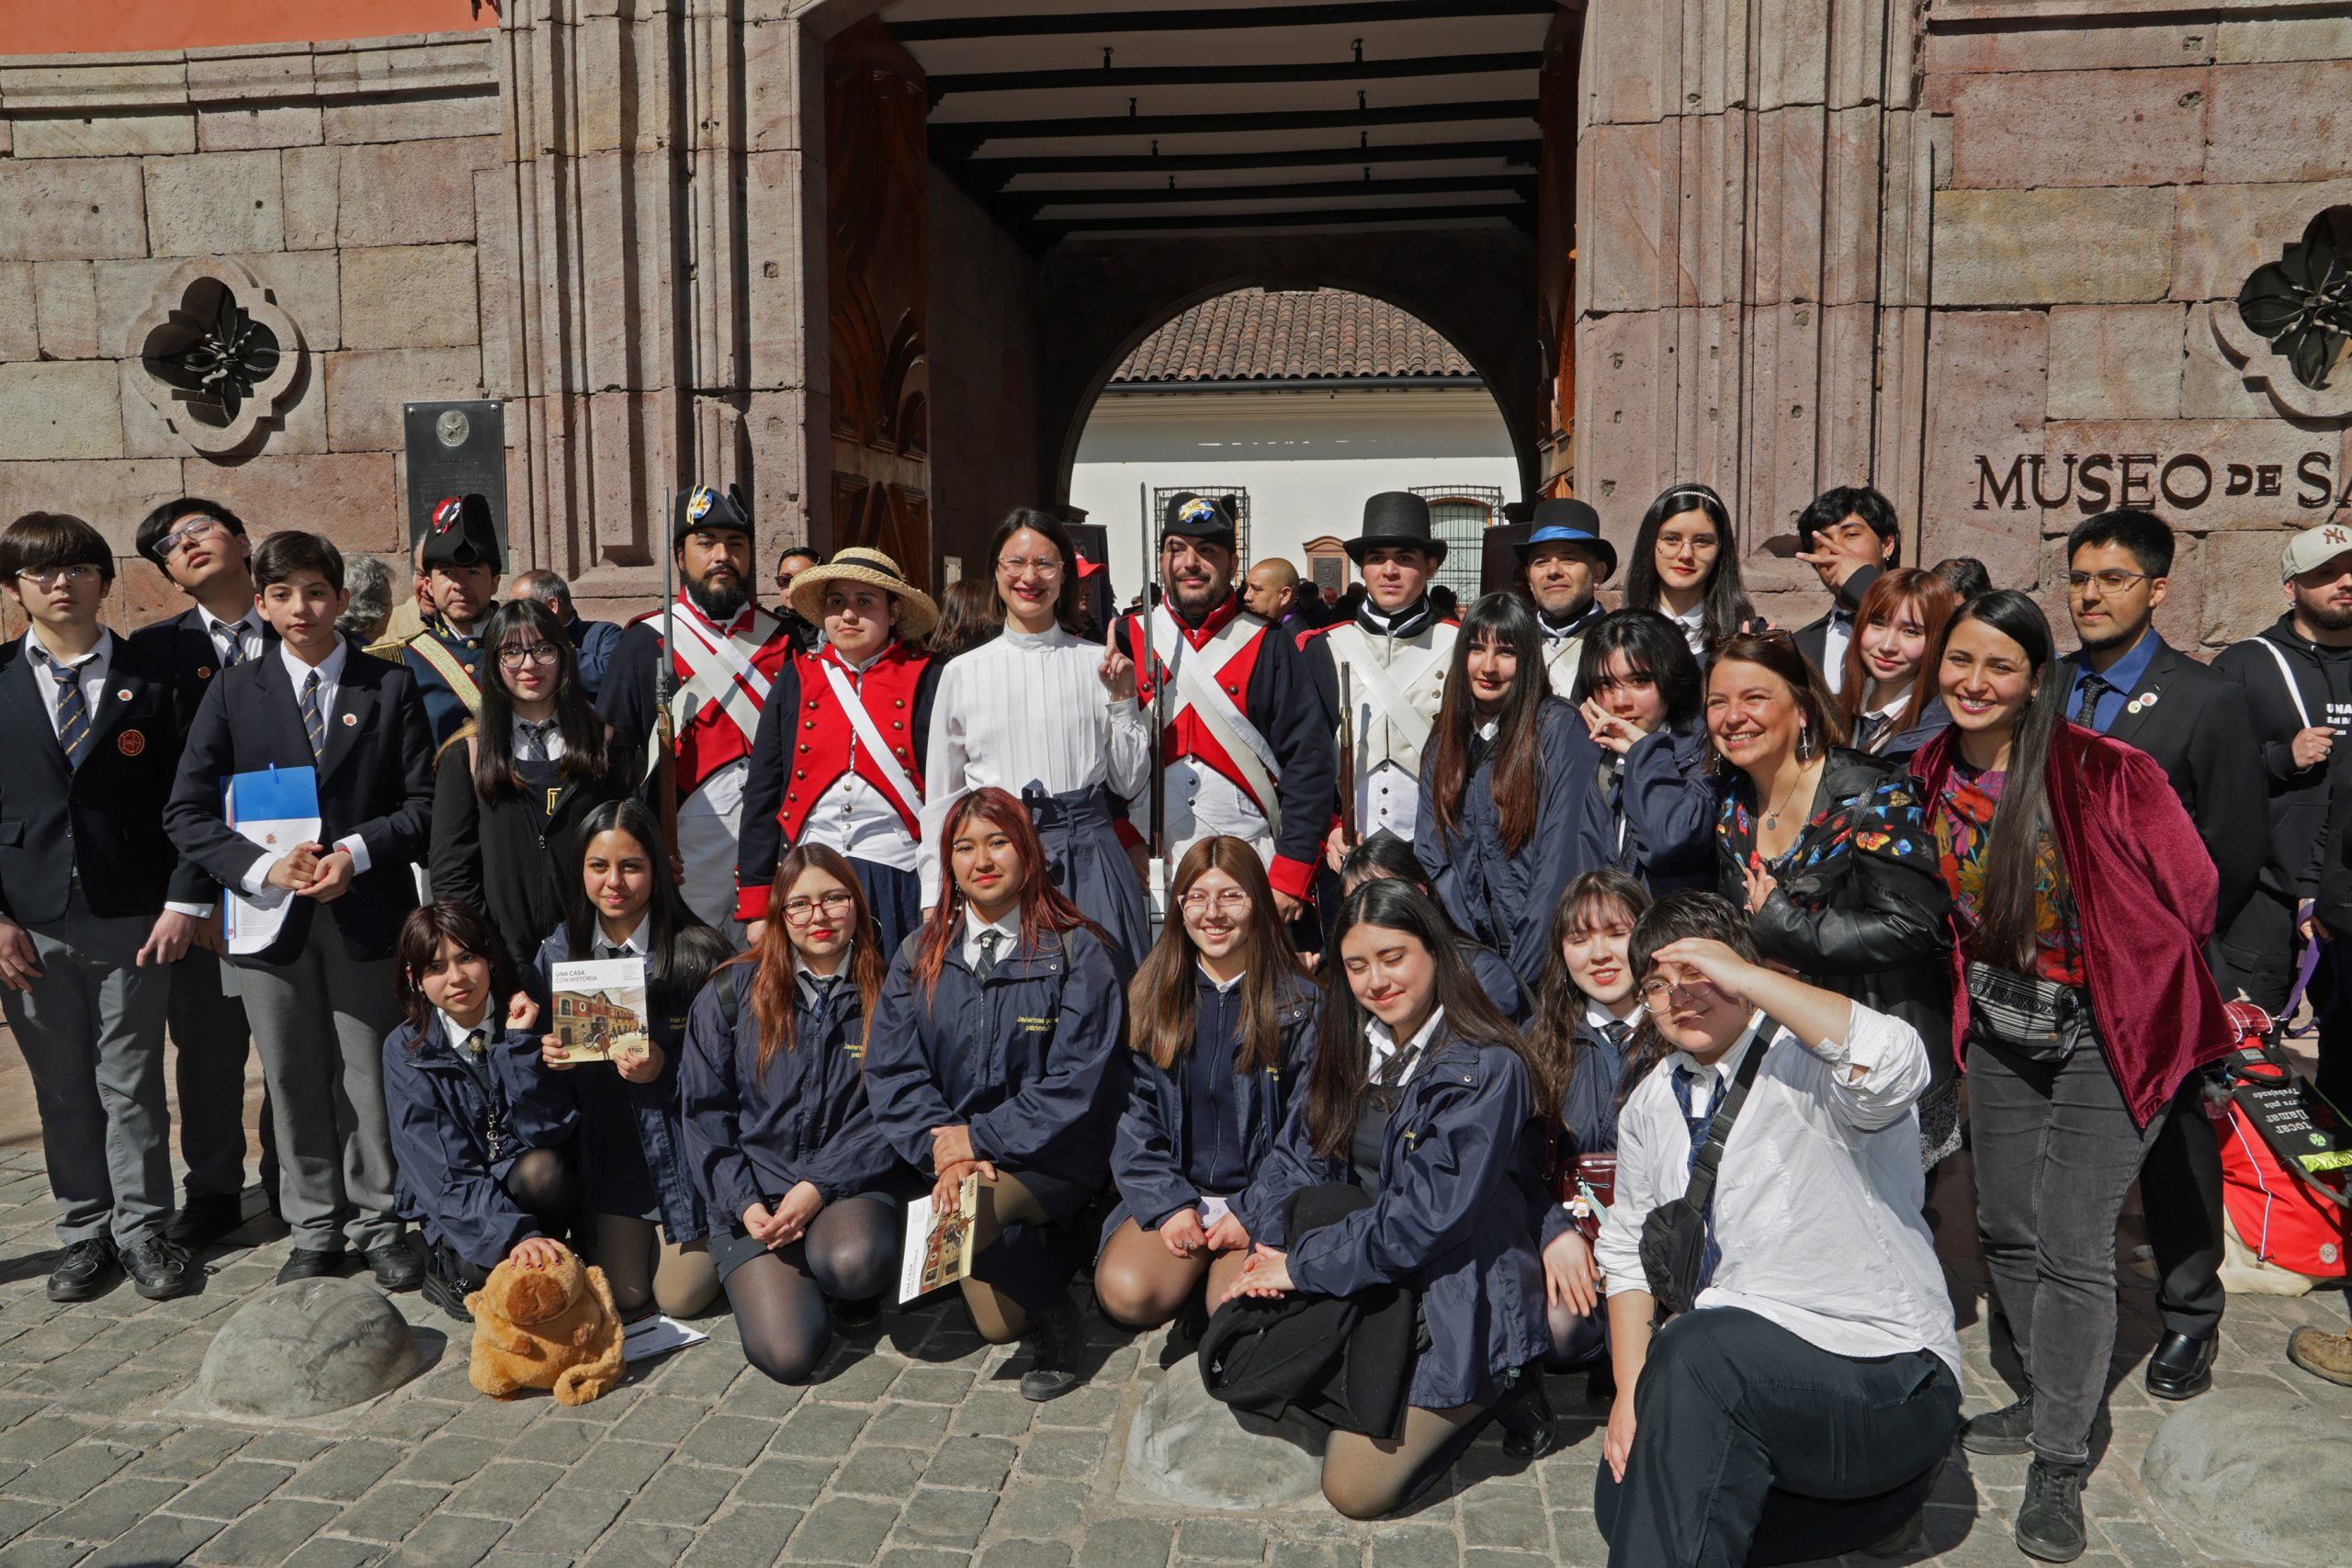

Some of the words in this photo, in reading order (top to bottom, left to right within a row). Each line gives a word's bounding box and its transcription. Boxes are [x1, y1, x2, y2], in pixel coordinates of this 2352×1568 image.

[1973, 454, 2211, 513] MUSEO
[2225, 464, 2282, 496] DE
[2253, 1089, 2300, 1099] Trabajando
[2266, 1110, 2310, 1122] llamar
[2276, 1122, 2312, 1134] tocar
